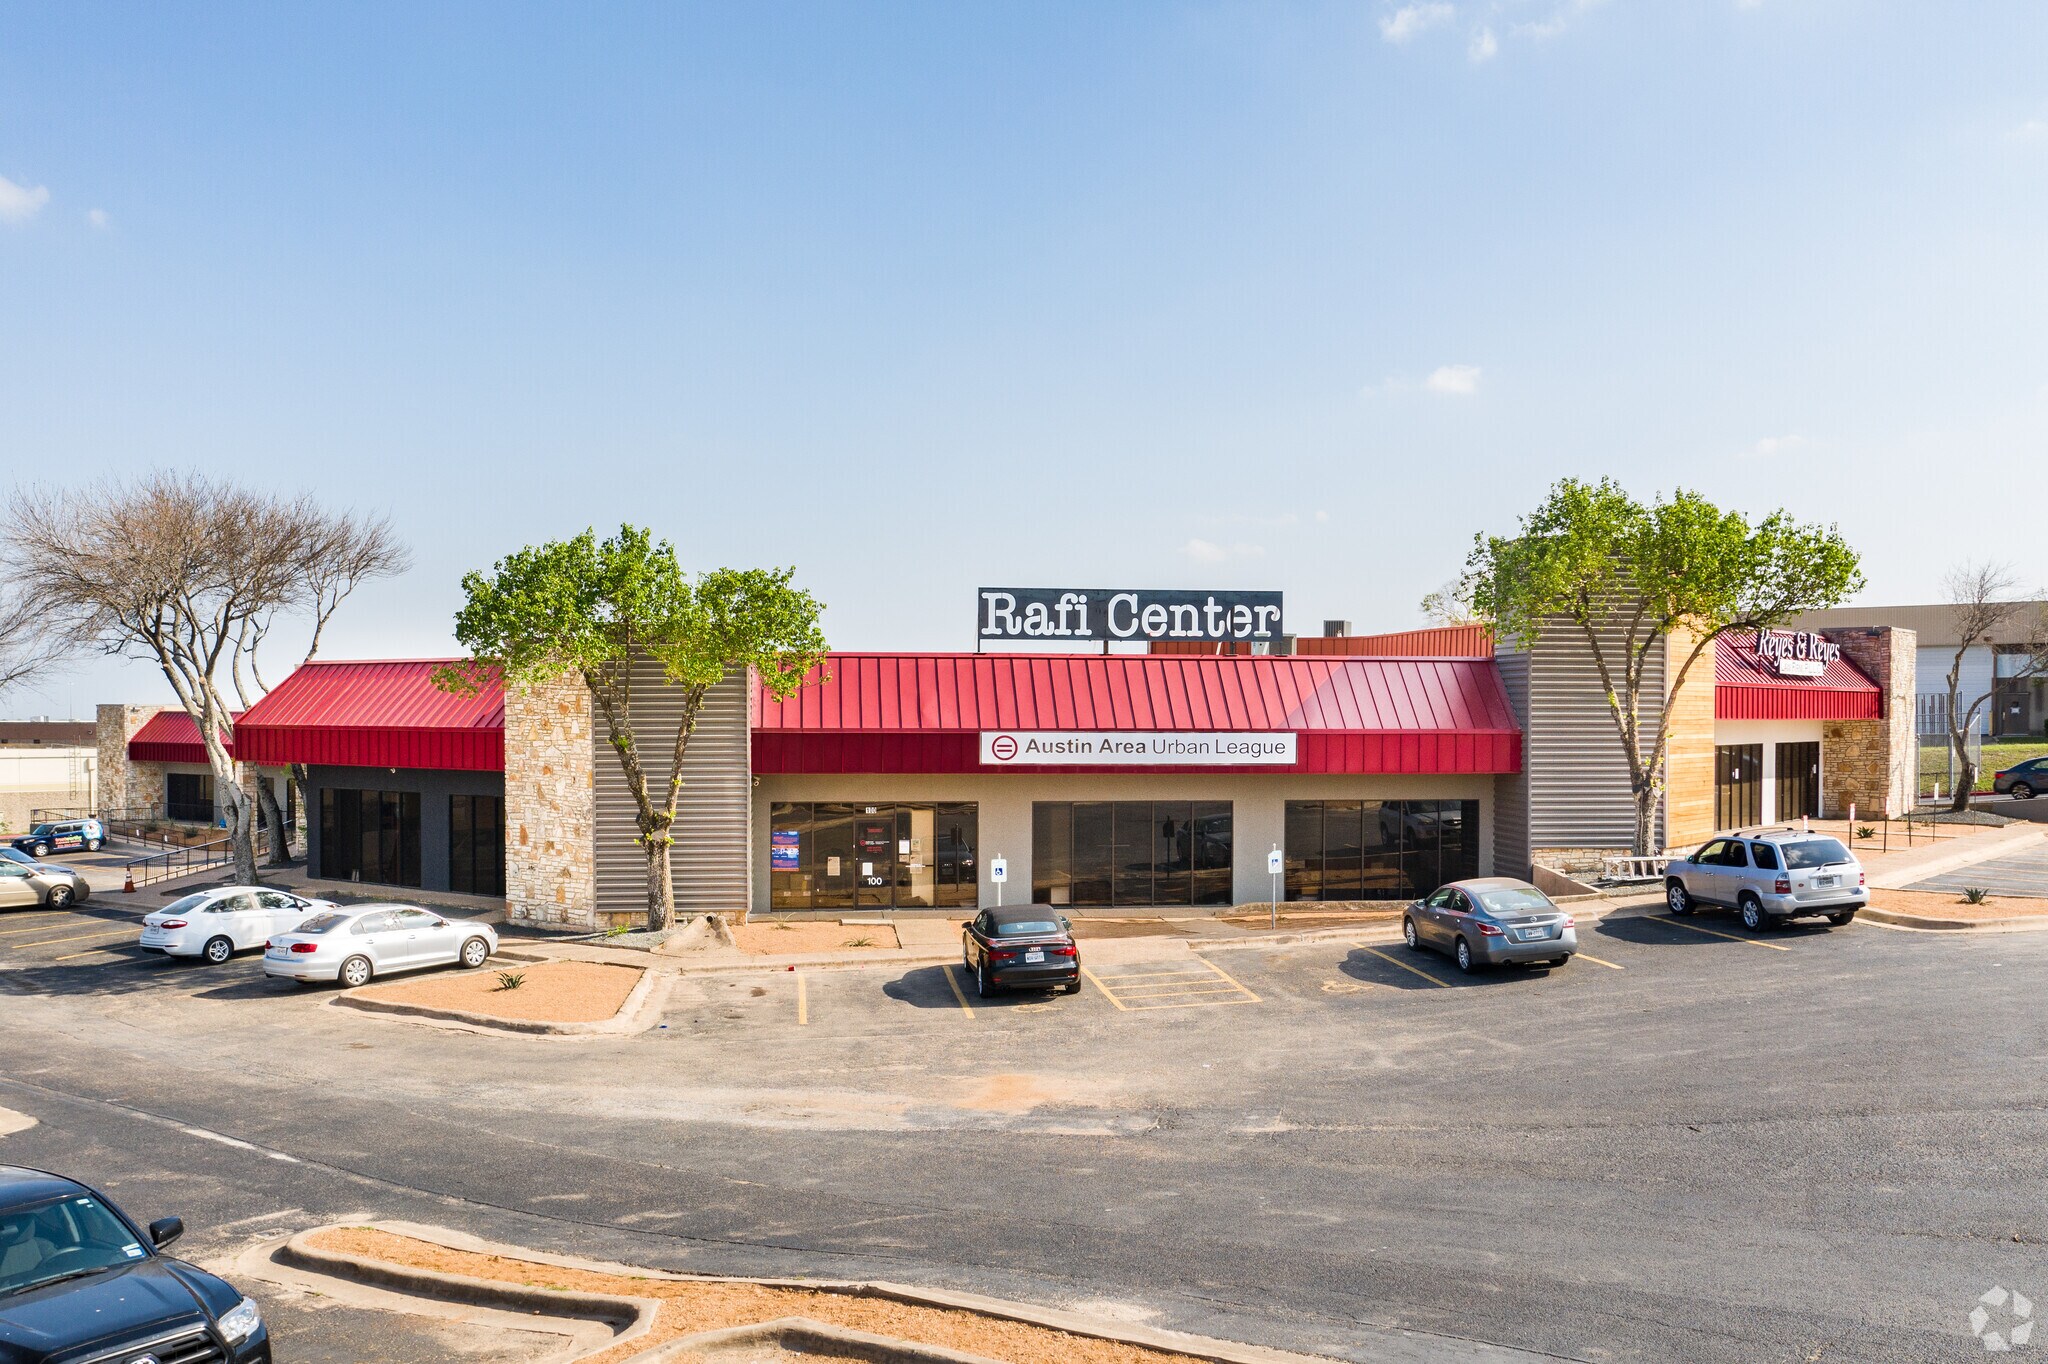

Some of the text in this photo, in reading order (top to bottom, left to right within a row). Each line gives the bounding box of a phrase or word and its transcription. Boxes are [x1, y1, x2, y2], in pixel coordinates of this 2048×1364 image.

[981, 592, 1281, 637] Rafi Center
[1796, 632, 1807, 659] &
[1808, 632, 1840, 670] Reyes
[1025, 738, 1286, 758] Austin Area Urban League
[867, 877, 883, 885] 100
